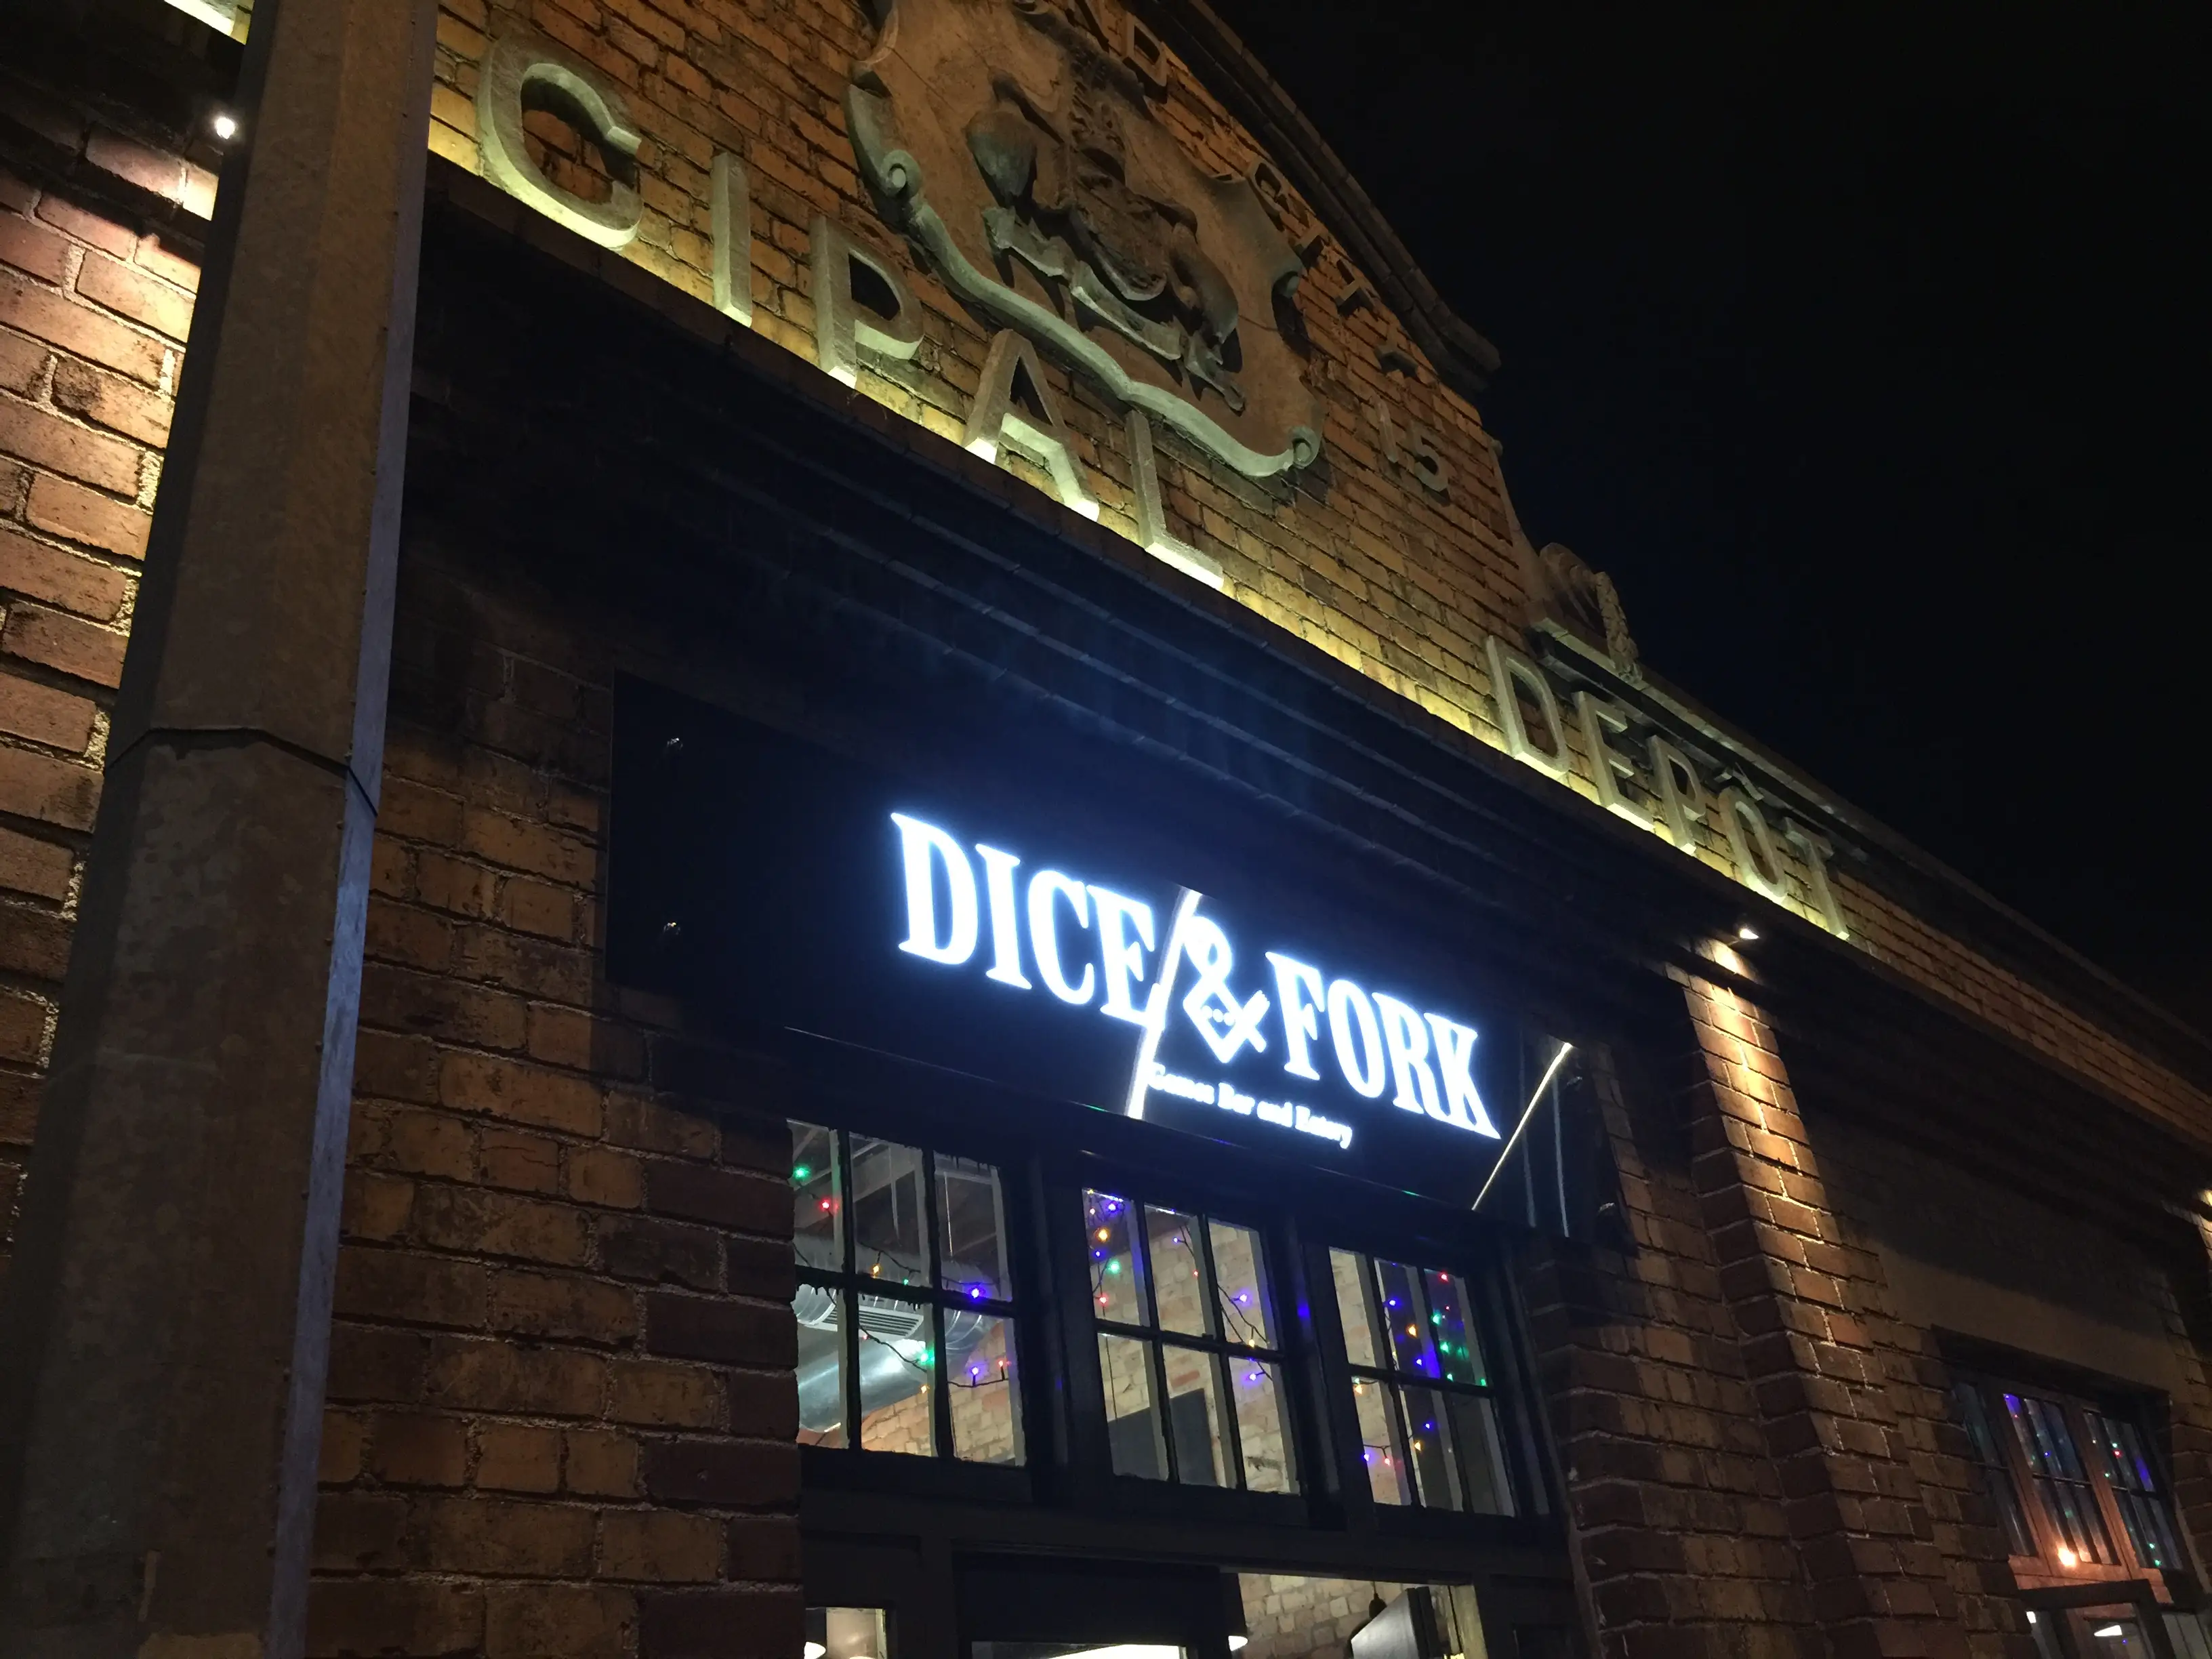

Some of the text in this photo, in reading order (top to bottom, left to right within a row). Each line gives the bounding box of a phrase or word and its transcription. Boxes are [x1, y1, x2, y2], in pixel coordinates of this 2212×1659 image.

[889, 811, 1502, 1140] DICE & FORK
[1217, 1082, 1254, 1115] Bar
[1256, 1101, 1292, 1128] and
